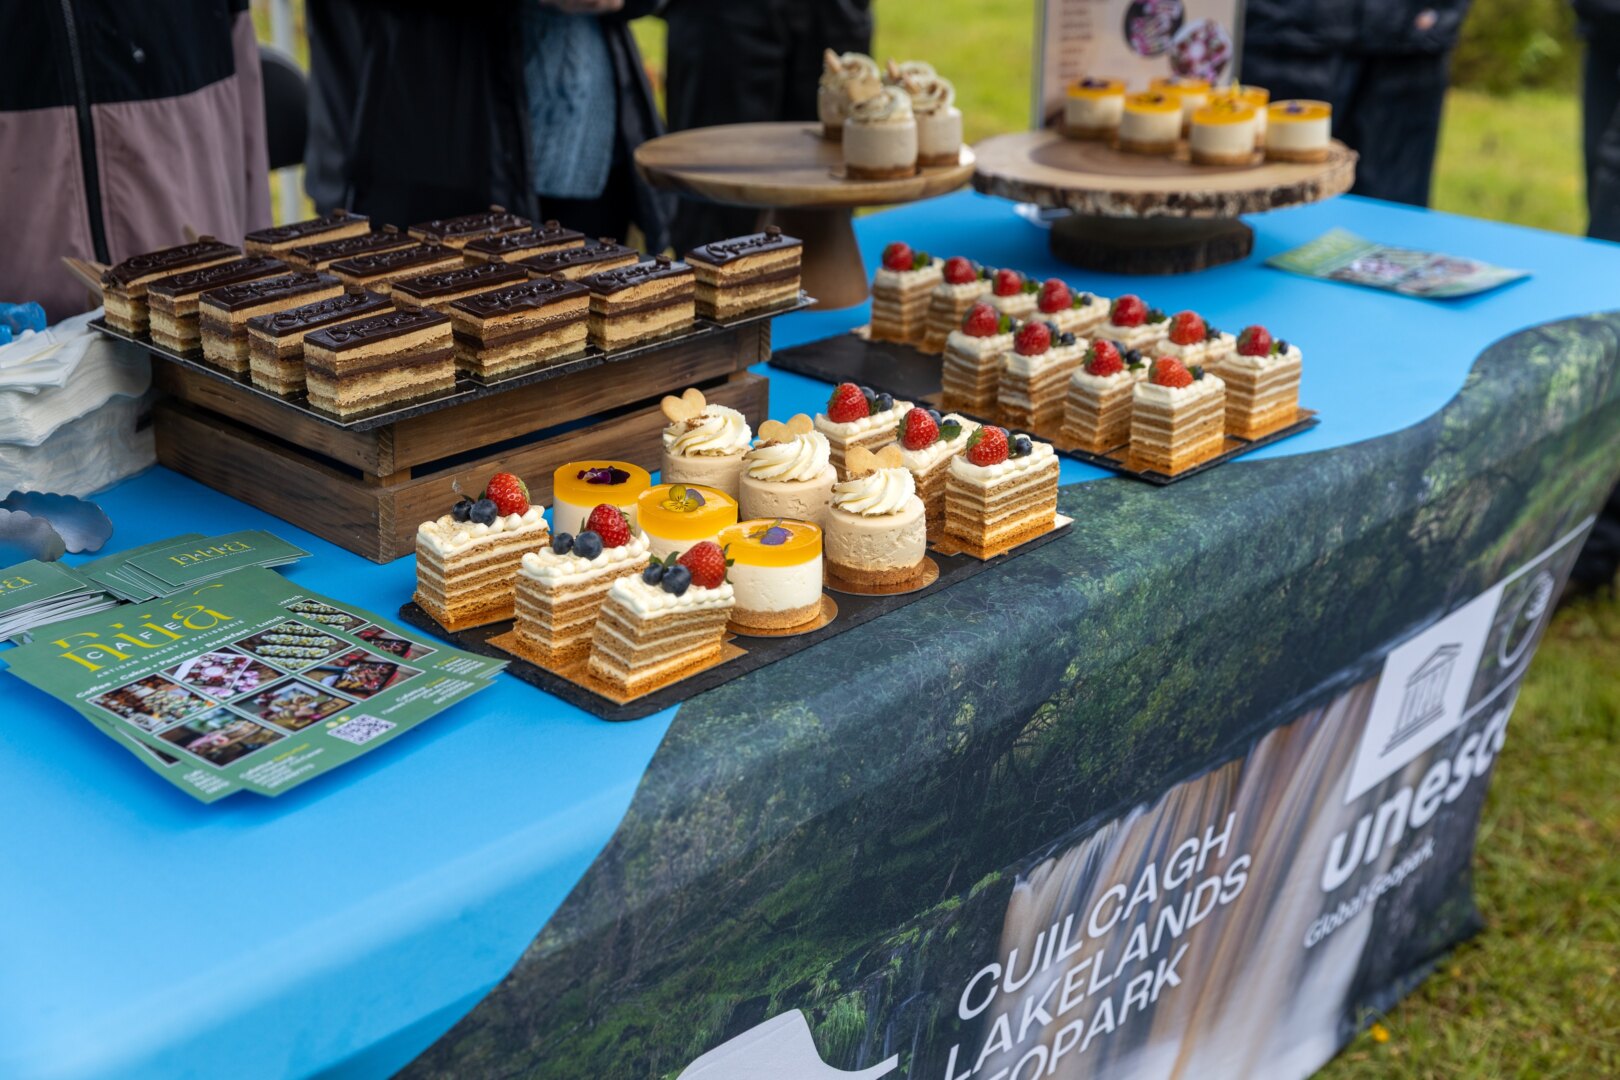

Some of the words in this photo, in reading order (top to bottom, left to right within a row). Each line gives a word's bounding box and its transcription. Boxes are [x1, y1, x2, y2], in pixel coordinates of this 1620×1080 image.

[75, 680, 112, 698] Coffee
[120, 665, 152, 681] Cakes
[158, 647, 199, 667] Pastries
[204, 628, 250, 649] Breakfast
[256, 614, 286, 629] Lunch
[943, 854, 1251, 1080] LAKELANDS
[958, 812, 1236, 1021] CUILCAGH
[1303, 886, 1368, 949] Global
[1365, 838, 1435, 903] Geopark
